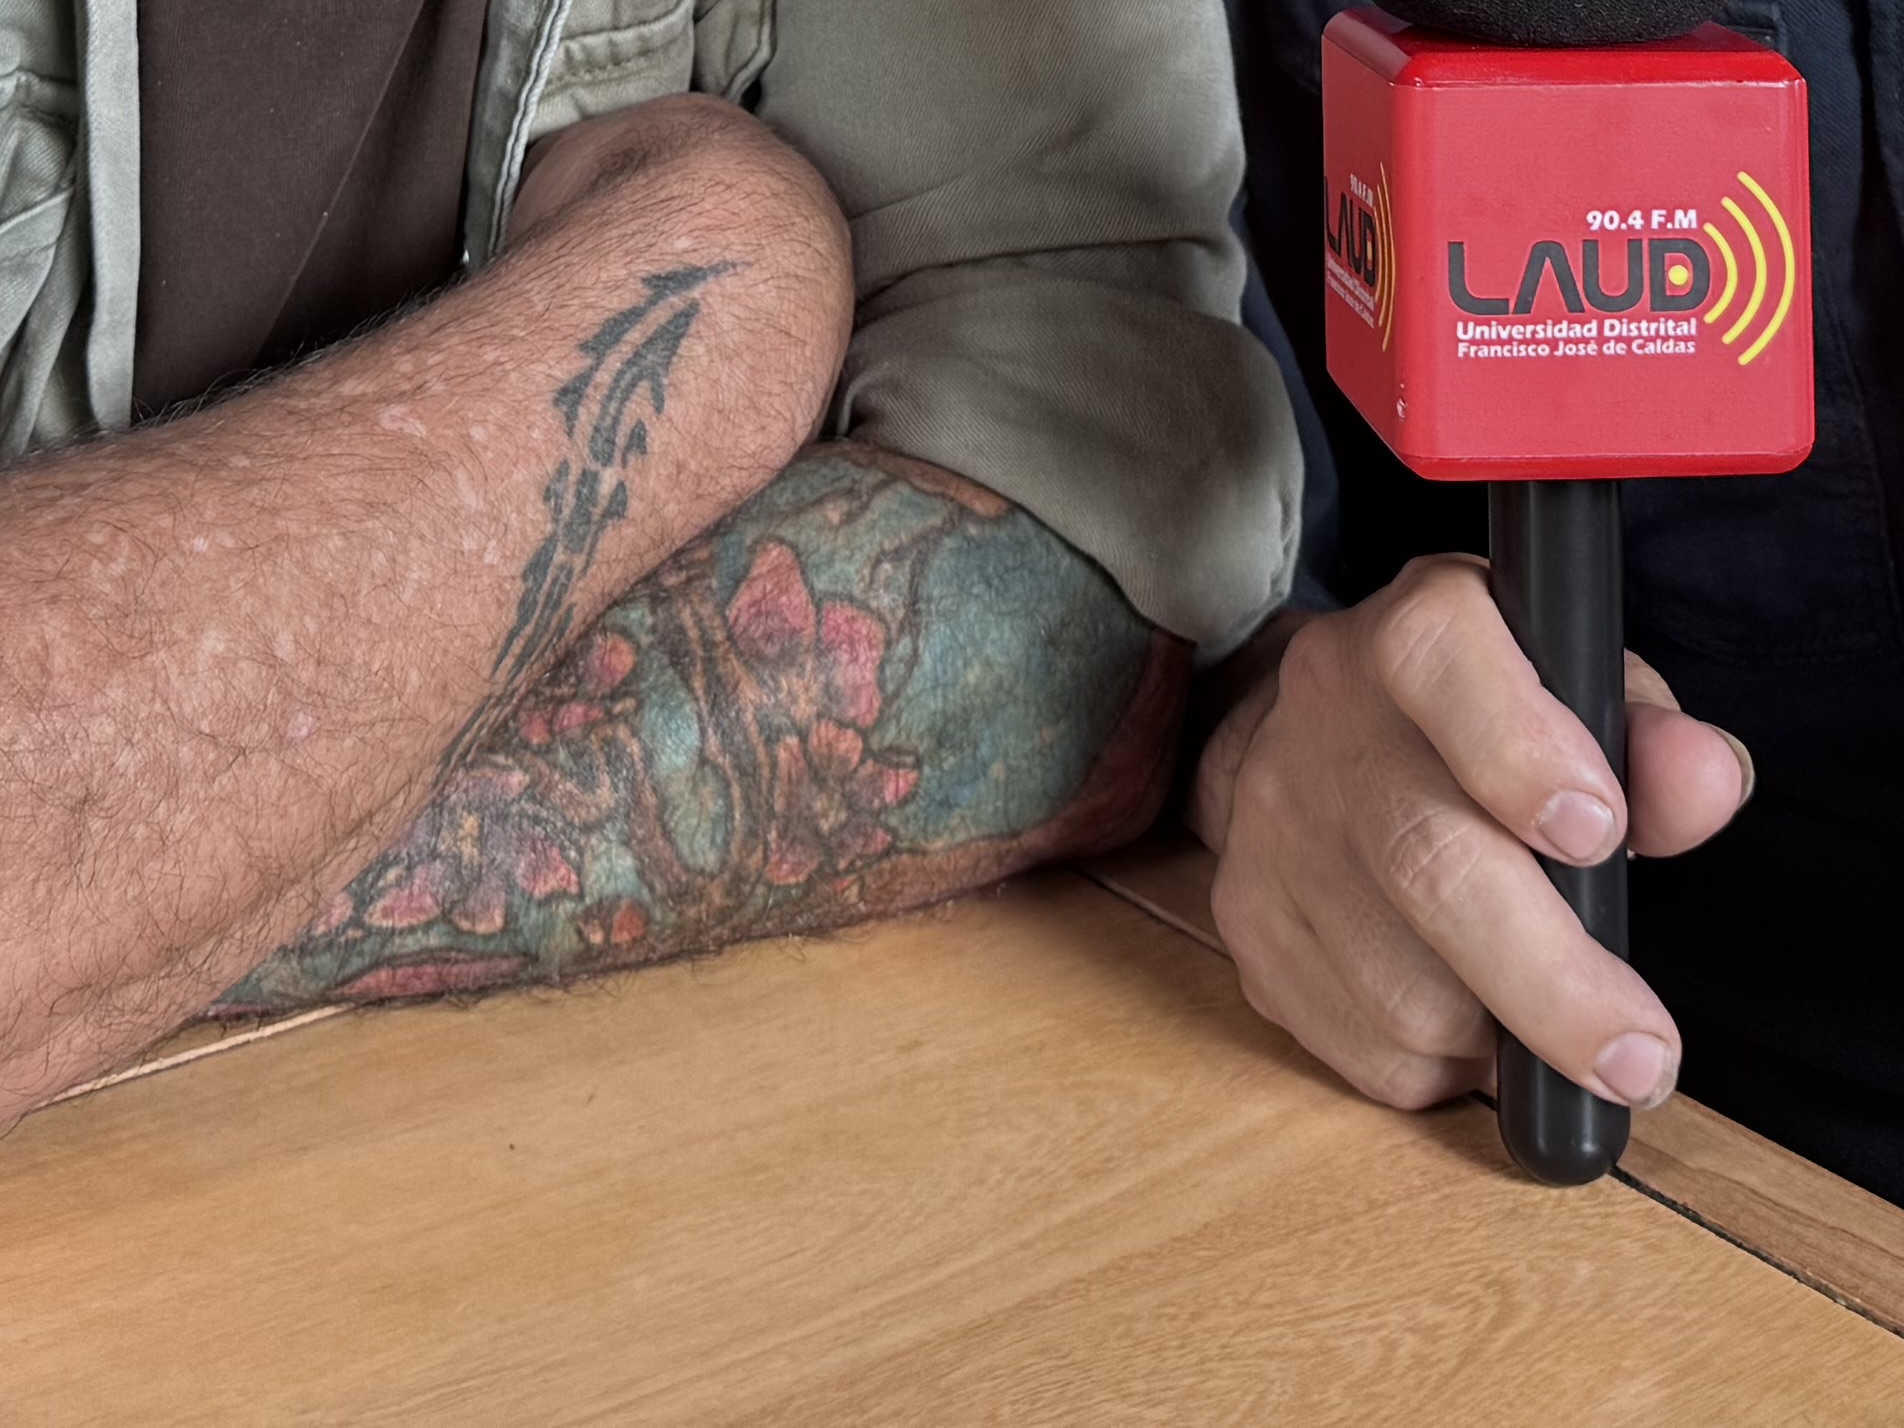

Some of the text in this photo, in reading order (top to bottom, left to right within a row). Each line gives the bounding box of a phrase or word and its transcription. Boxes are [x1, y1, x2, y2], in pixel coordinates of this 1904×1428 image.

[1586, 208, 1698, 231] 90.4 F.M
[1447, 238, 1711, 316] LAUD
[1456, 317, 1697, 341] Universidad Distrital
[1457, 338, 1696, 358] Francisco José de Caldas
